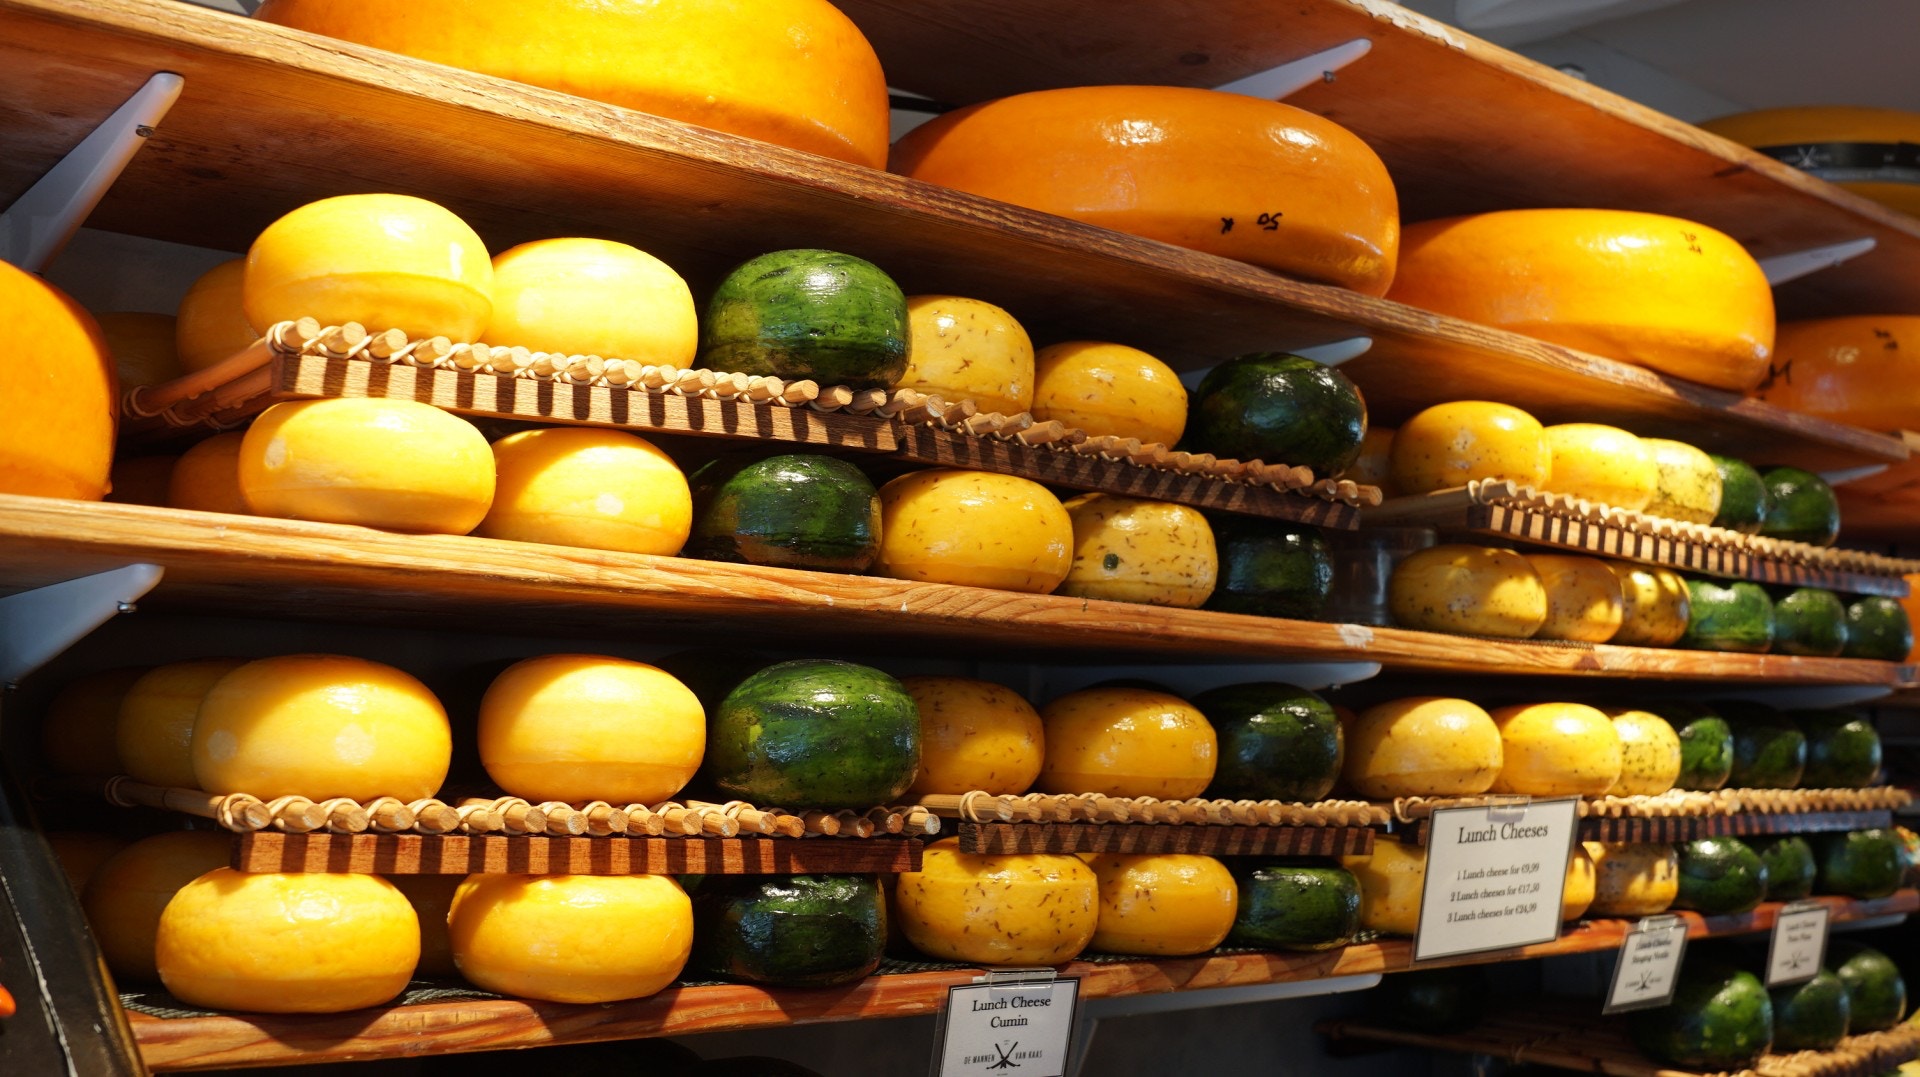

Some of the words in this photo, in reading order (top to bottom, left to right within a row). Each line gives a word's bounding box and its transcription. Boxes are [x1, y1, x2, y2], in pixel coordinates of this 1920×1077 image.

[1457, 825, 1497, 844] Lunch
[1501, 822, 1549, 840] Cheeses
[1463, 867, 1485, 880] Lunch
[1486, 865, 1508, 877] cheese
[1510, 864, 1520, 874] for
[1450, 893, 1455, 902] 2
[1456, 888, 1479, 901] Lunch
[1480, 888, 1506, 898] cheeses
[1507, 886, 1517, 896] for
[1453, 909, 1476, 922] Lunch
[1477, 909, 1503, 919] cheeses
[1504, 906, 1514, 917] for
[972, 998, 1007, 1012] Lunch
[1011, 996, 1051, 1009] Cheese
[990, 1015, 1028, 1028] Cumin
[1015, 1051, 1027, 1060] VAN
[1028, 1050, 1043, 1059] KAAS
